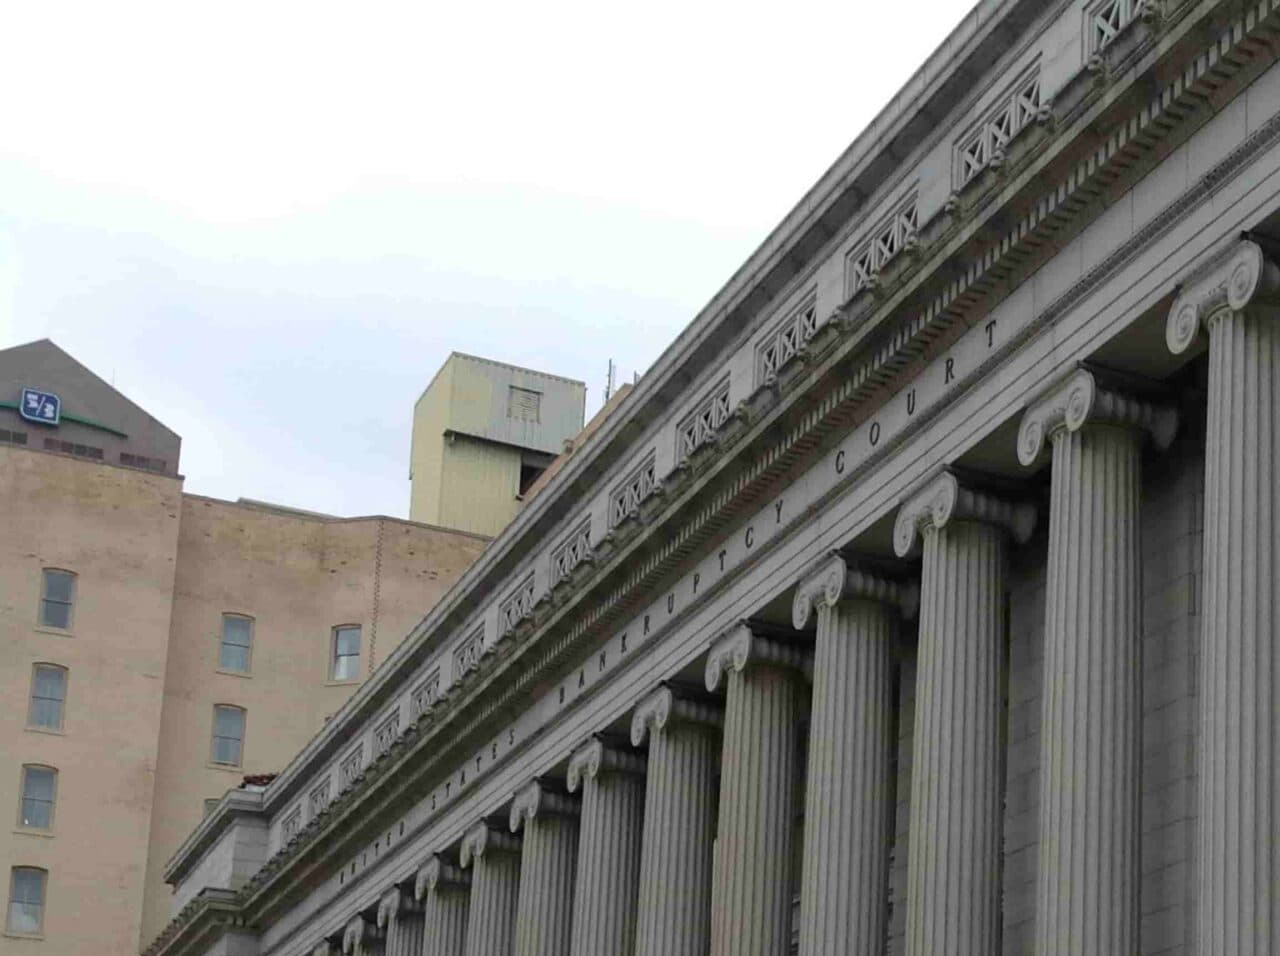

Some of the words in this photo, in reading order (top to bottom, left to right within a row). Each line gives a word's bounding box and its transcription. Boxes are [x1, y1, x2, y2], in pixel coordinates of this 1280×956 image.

[339, 821, 405, 884] UNITED
[431, 728, 516, 811] STATES
[559, 502, 784, 705] BANKRUPTCY
[834, 319, 998, 475] COURT
